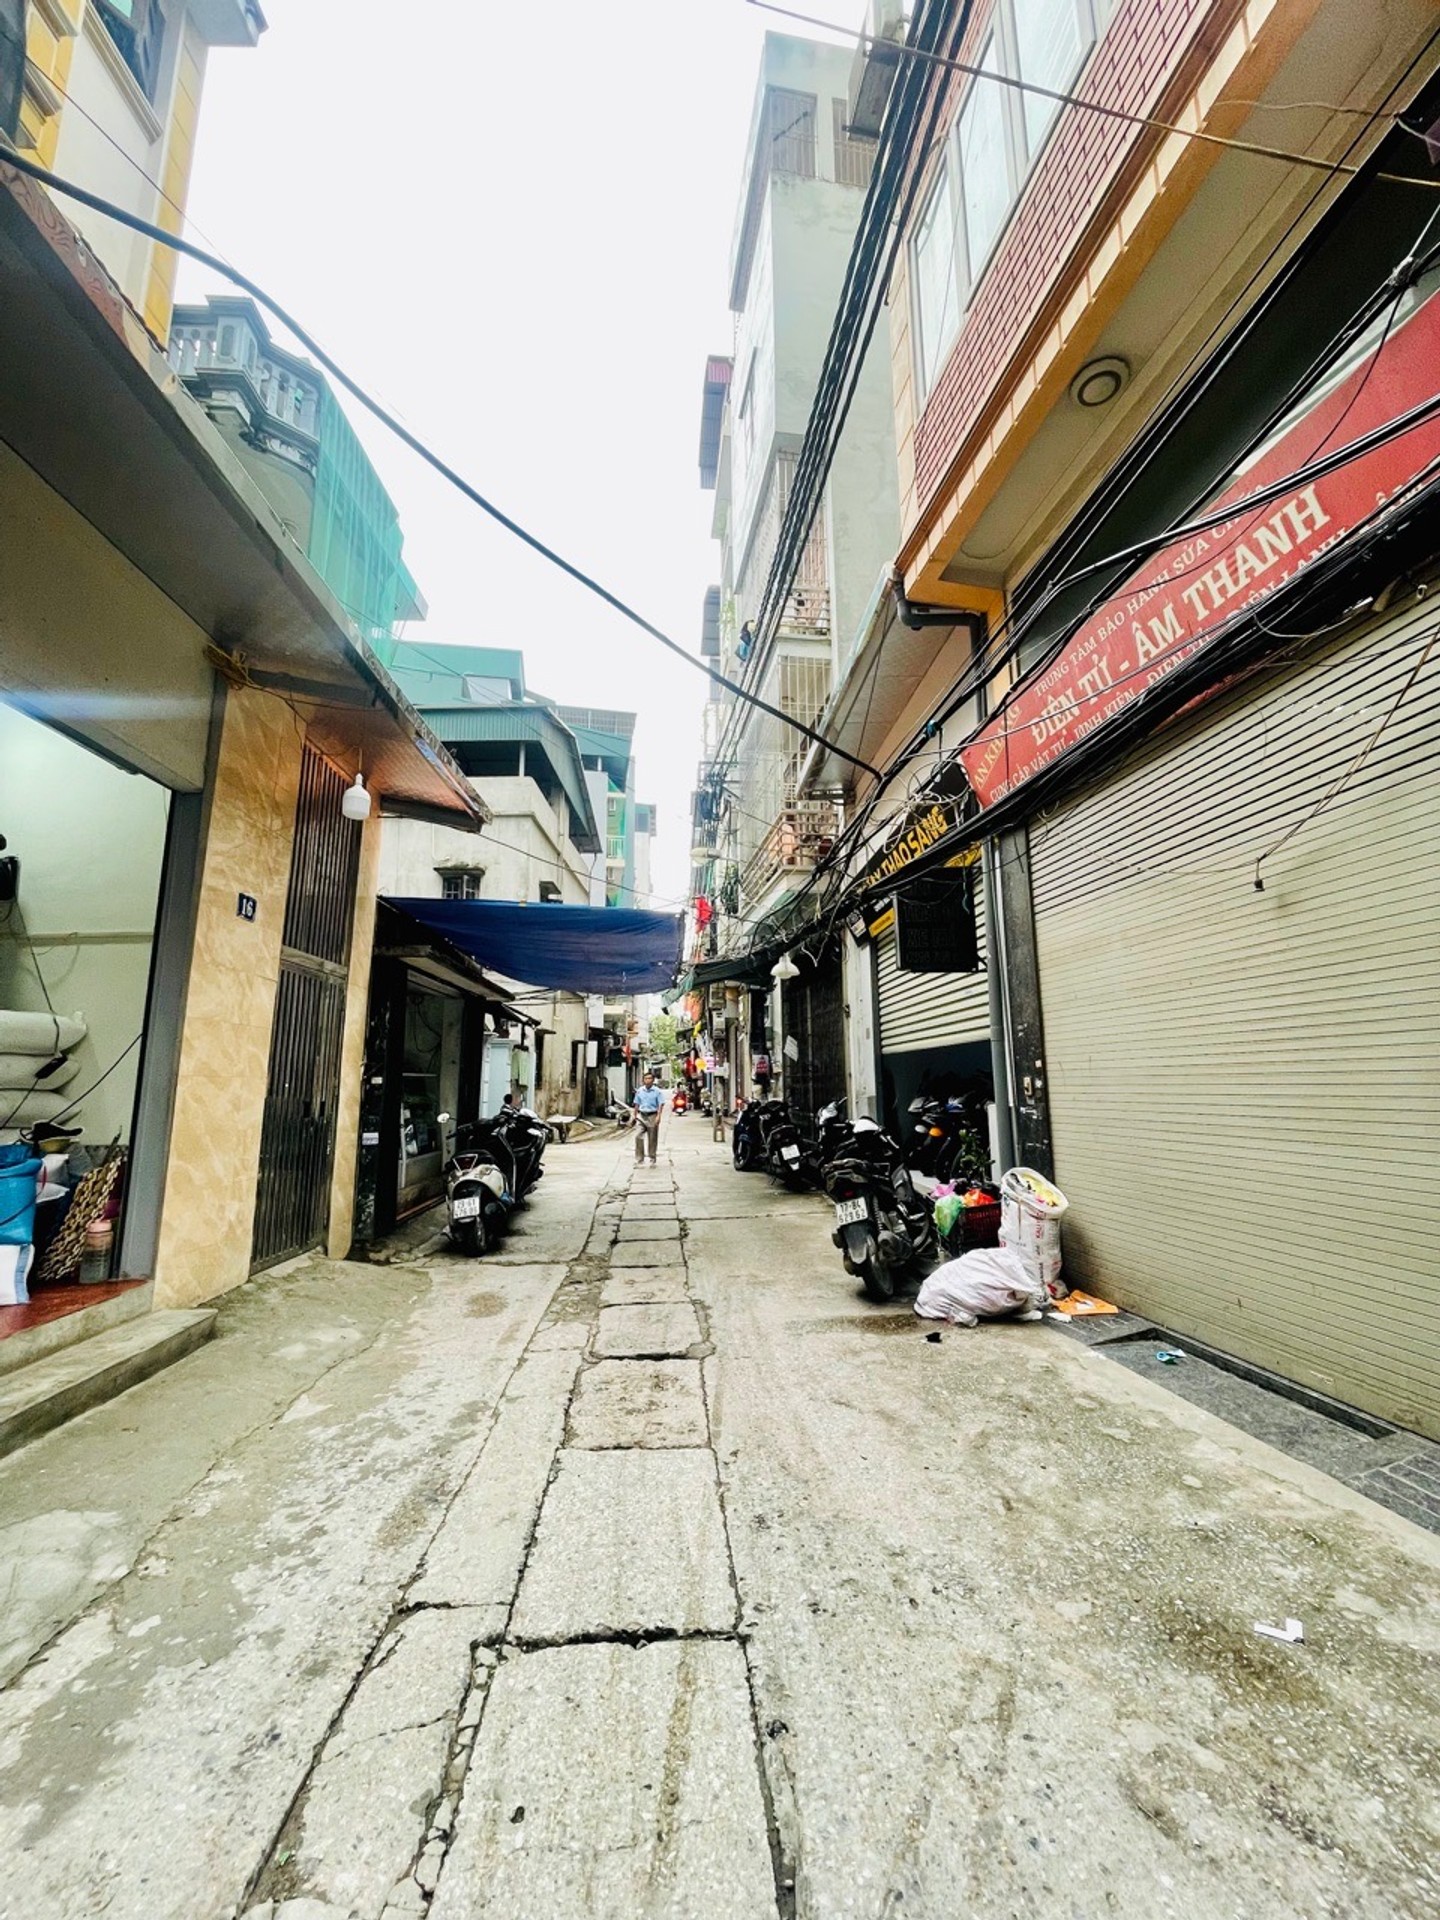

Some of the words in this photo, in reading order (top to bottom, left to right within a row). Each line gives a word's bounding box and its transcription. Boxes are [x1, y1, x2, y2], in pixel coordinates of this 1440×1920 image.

[1132, 602, 1185, 668] ÂM
[1182, 480, 1331, 621] THANH
[1033, 661, 1070, 698] TRUNG
[241, 898, 253, 917] 16
